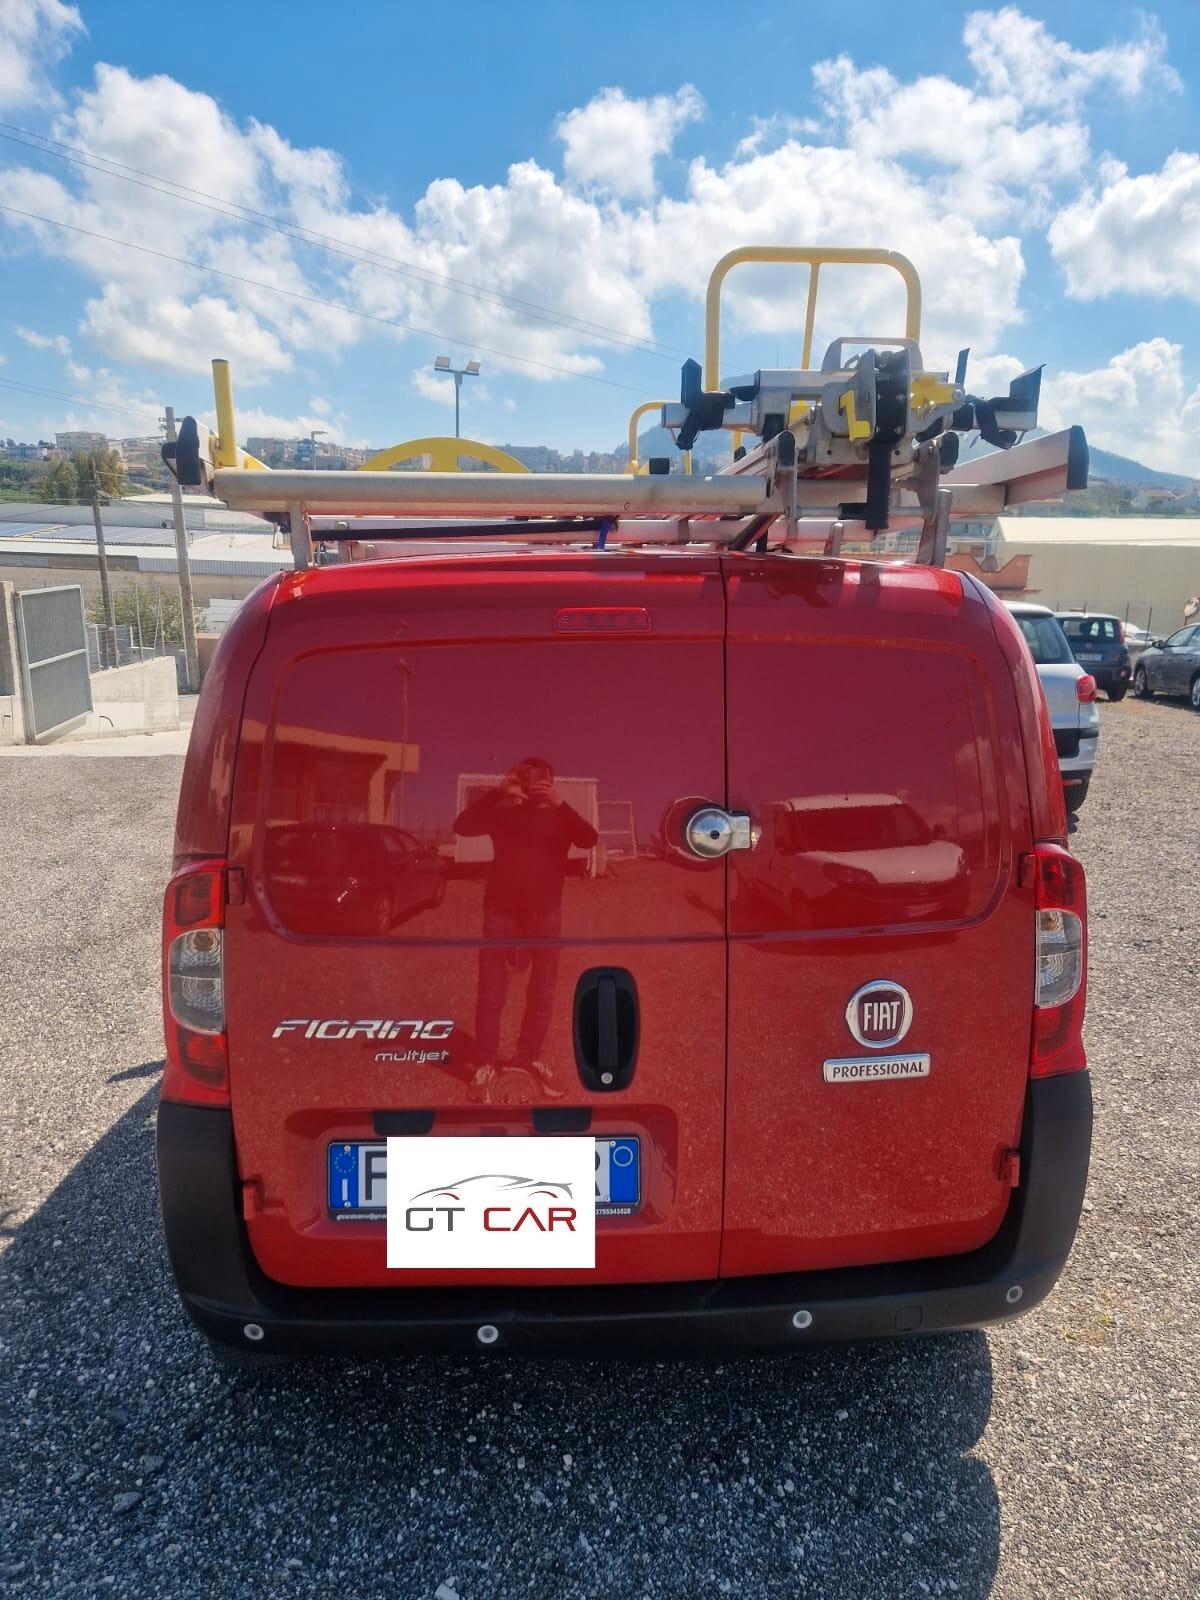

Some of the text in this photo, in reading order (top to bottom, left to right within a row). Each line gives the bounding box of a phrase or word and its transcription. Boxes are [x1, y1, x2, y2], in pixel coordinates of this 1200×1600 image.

[863, 1001, 900, 1031] FIAT
[272, 1019, 454, 1040] FIORINO
[374, 1050, 449, 1064] multijet
[832, 1061, 924, 1079] PROFESSIONAL
